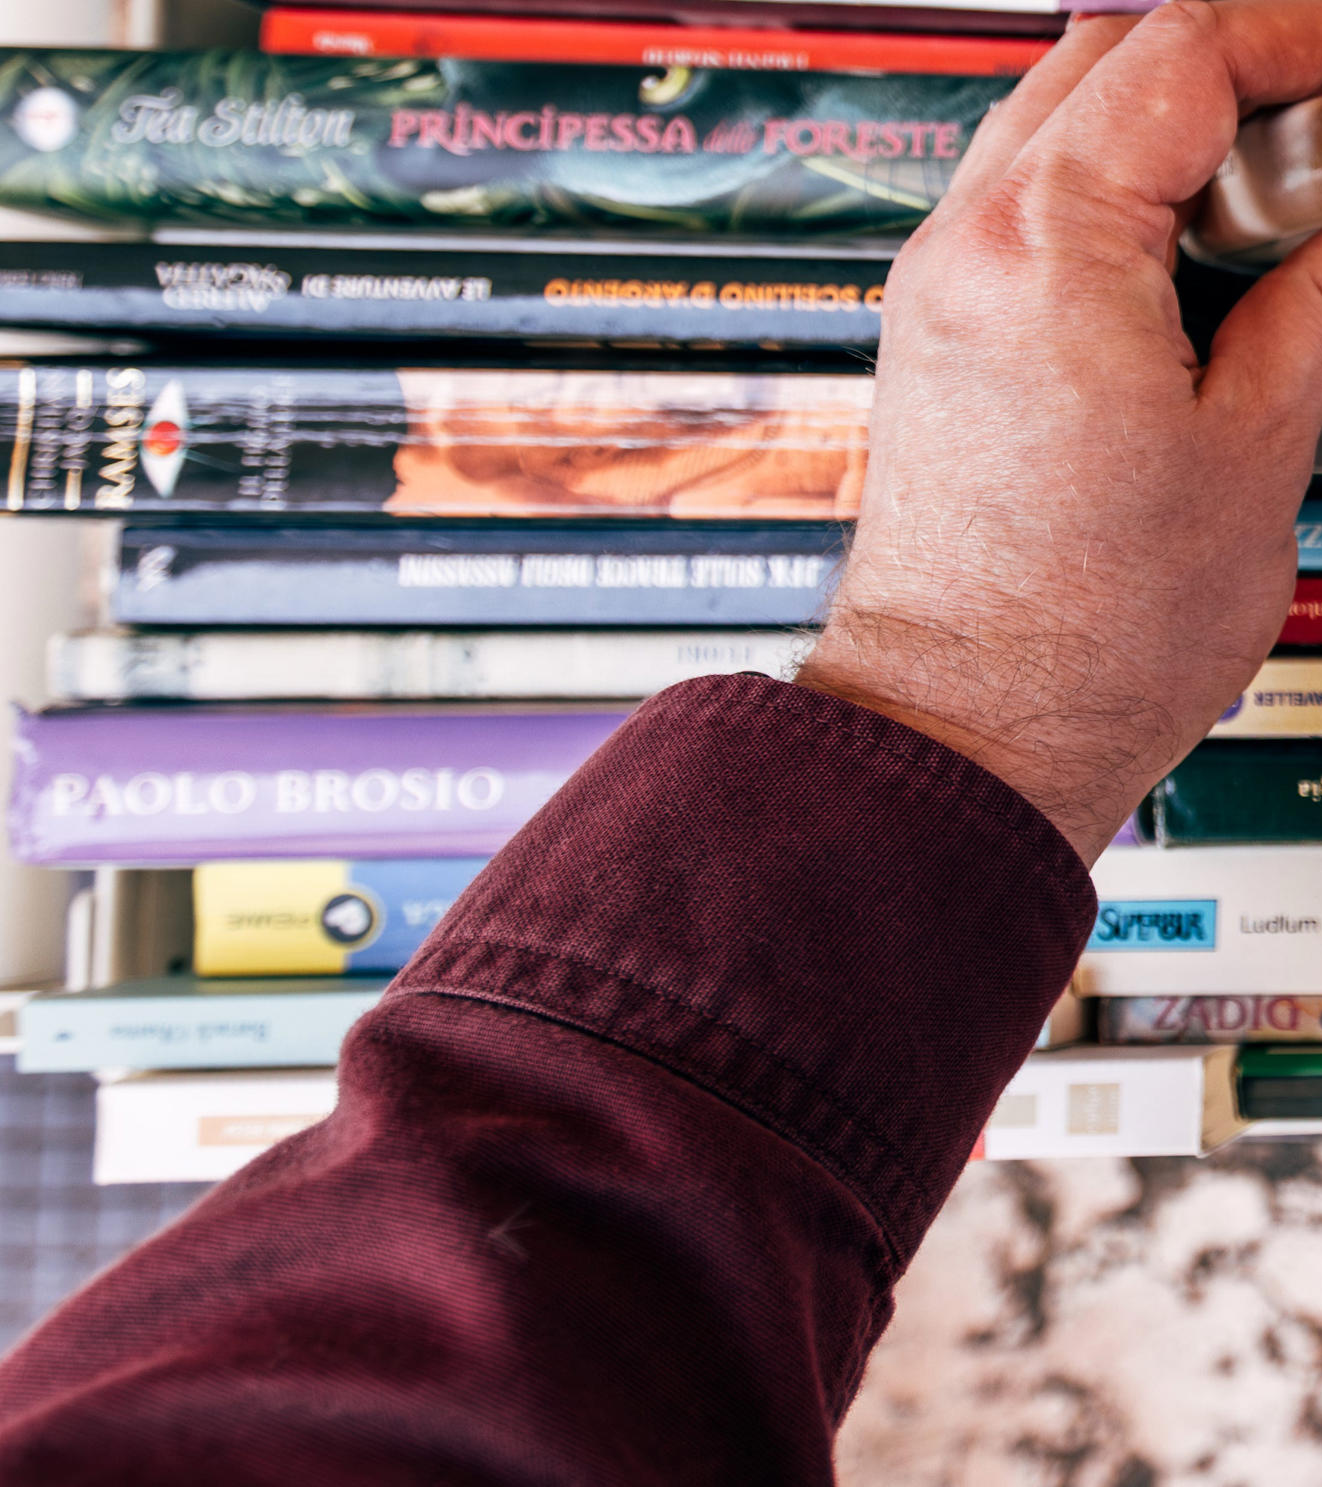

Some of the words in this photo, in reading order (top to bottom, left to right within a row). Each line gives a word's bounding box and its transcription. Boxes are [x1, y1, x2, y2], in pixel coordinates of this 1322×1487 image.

[386, 101, 697, 156] PRINCIPESSA
[760, 118, 961, 160] FORESTE
[719, 278, 860, 311] SCELLINO
[51, 769, 259, 818] PAOLO
[276, 766, 505, 815] BROSIO
[1240, 913, 1320, 936] Ludlum
